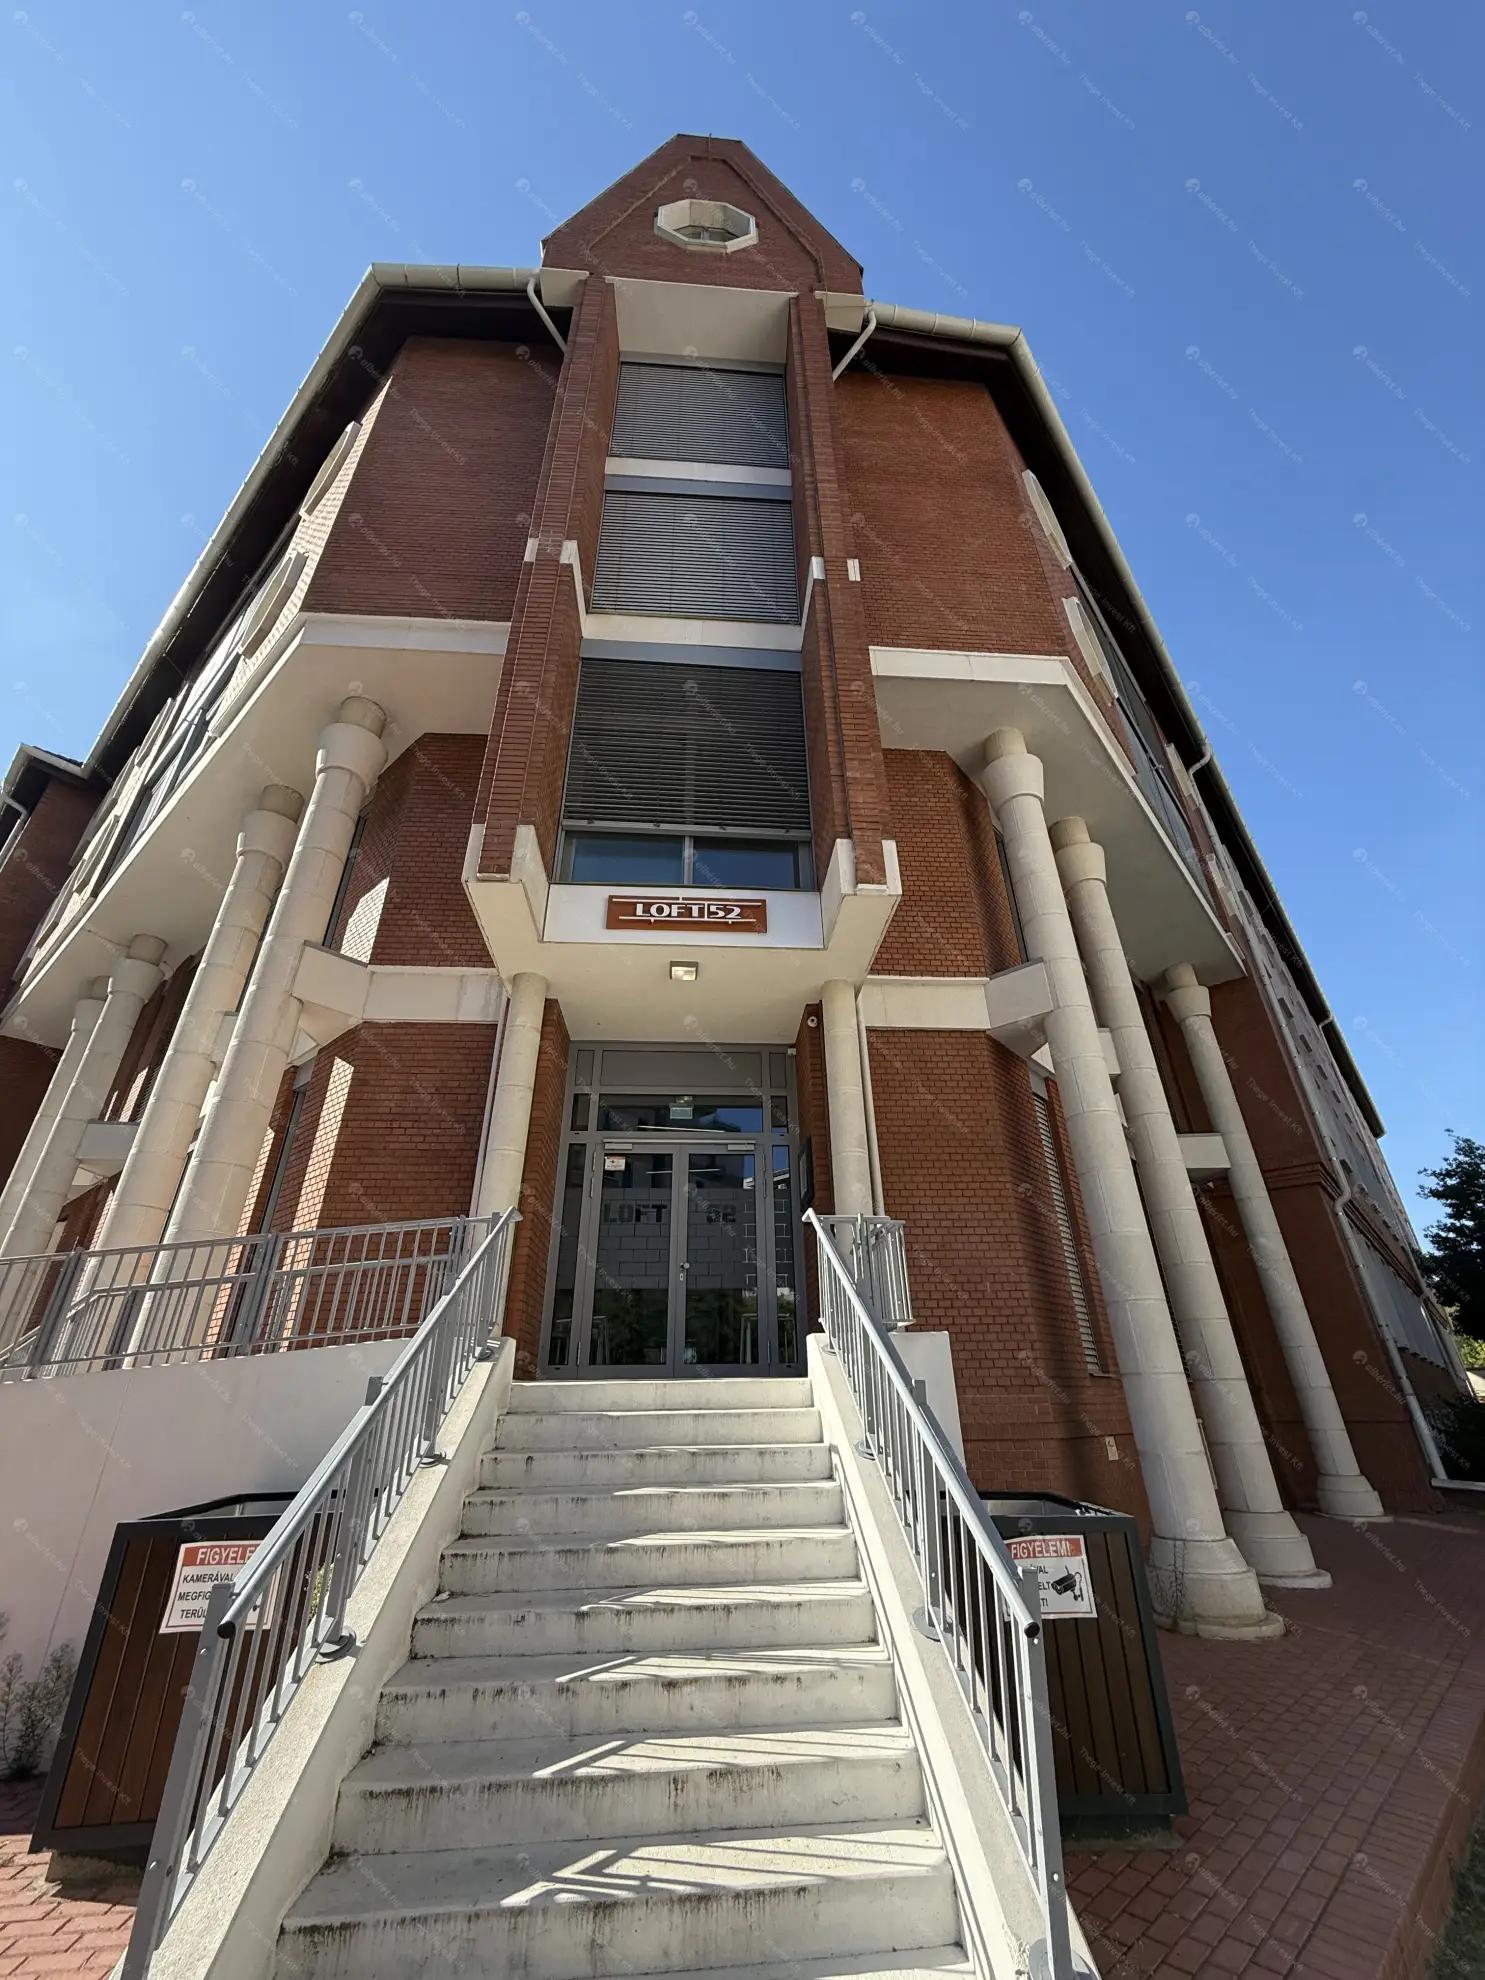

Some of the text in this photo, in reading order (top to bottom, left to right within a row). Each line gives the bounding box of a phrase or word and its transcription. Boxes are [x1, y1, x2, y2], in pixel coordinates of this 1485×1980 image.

[635, 902, 742, 919] LOFT 52
[196, 1547, 256, 1565] FIGYELE
[1011, 1540, 1071, 1559] FIGYELEM!
[182, 1571, 235, 1584] KAMERÁVAL
[177, 1590, 211, 1601] MEGFIG
[180, 1606, 207, 1619] TERÜL
